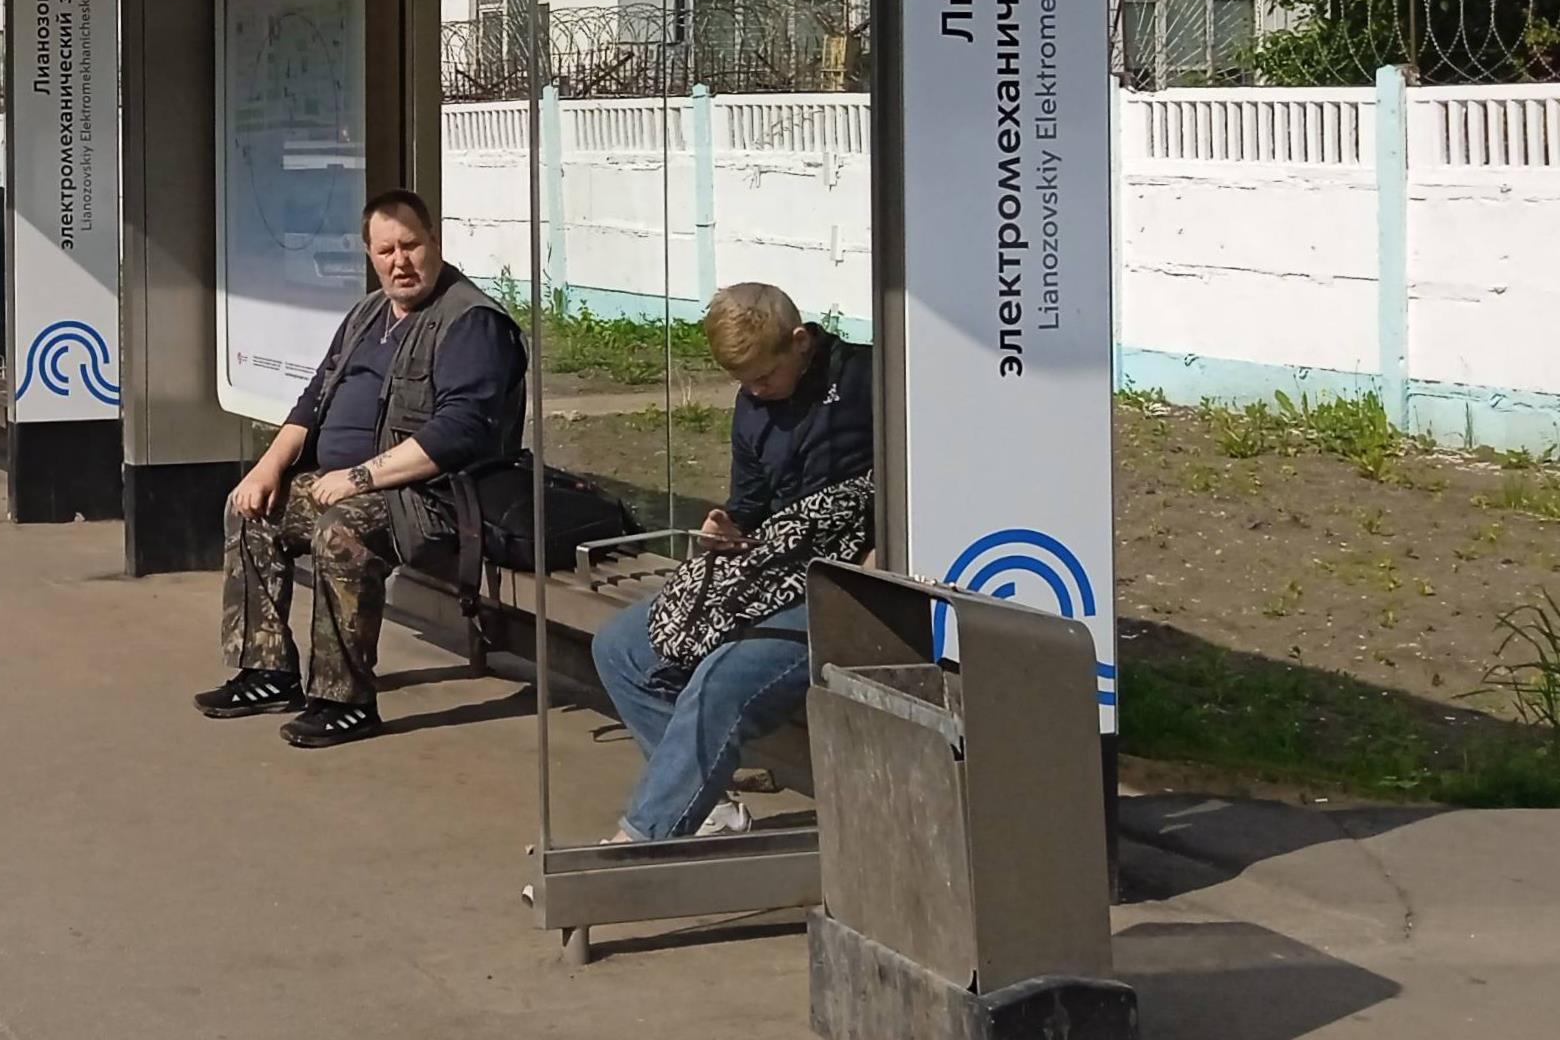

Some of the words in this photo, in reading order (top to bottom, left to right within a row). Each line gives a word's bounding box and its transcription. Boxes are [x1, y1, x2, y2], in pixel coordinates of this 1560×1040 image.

[55, 12, 77, 250] электромеханический
[80, 141, 95, 231] Lianozovskiy
[1034, 148, 1064, 330] Lianozovskiy
